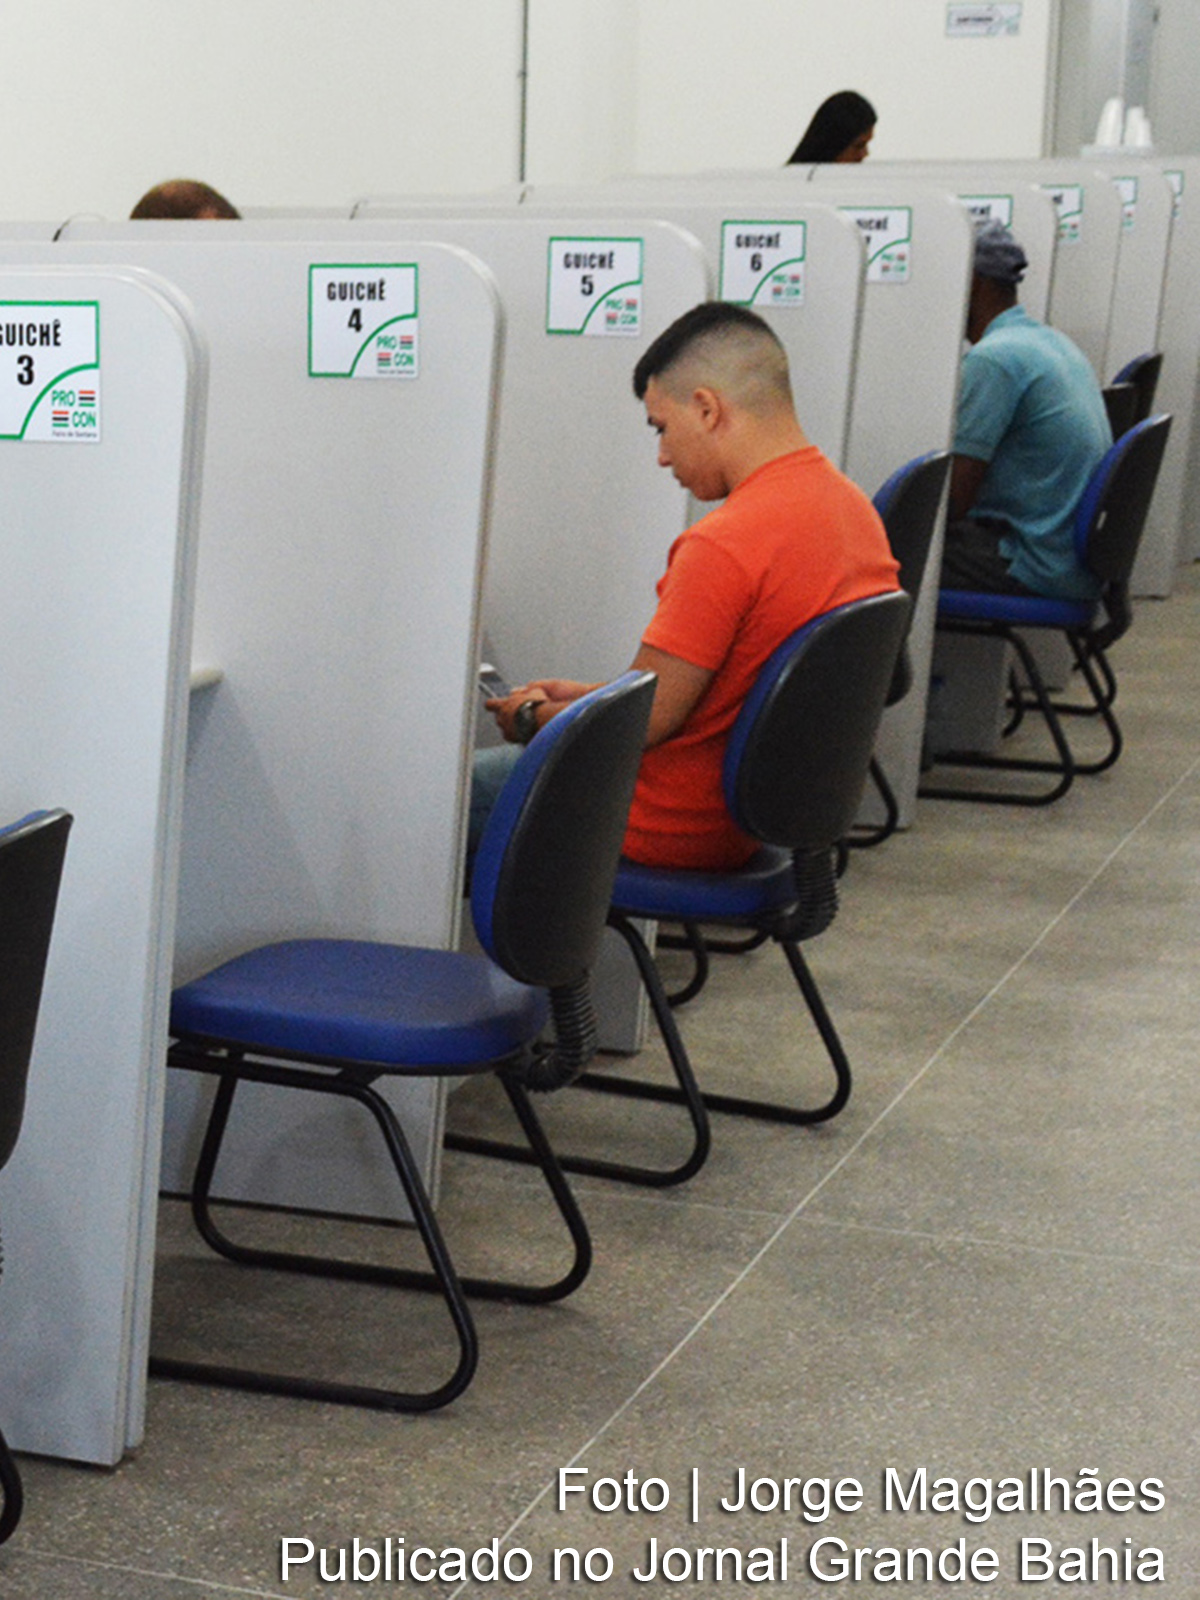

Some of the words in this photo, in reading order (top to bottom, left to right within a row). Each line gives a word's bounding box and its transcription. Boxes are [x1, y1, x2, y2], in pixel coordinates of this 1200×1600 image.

[563, 251, 614, 269] GUICHÊ
[750, 252, 762, 272] 6
[327, 277, 386, 301] GUICHÊ
[581, 275, 594, 296] 5
[348, 308, 362, 332] 4
[17, 354, 35, 386] 3
[52, 390, 76, 407] PRO
[72, 411, 97, 428] CON
